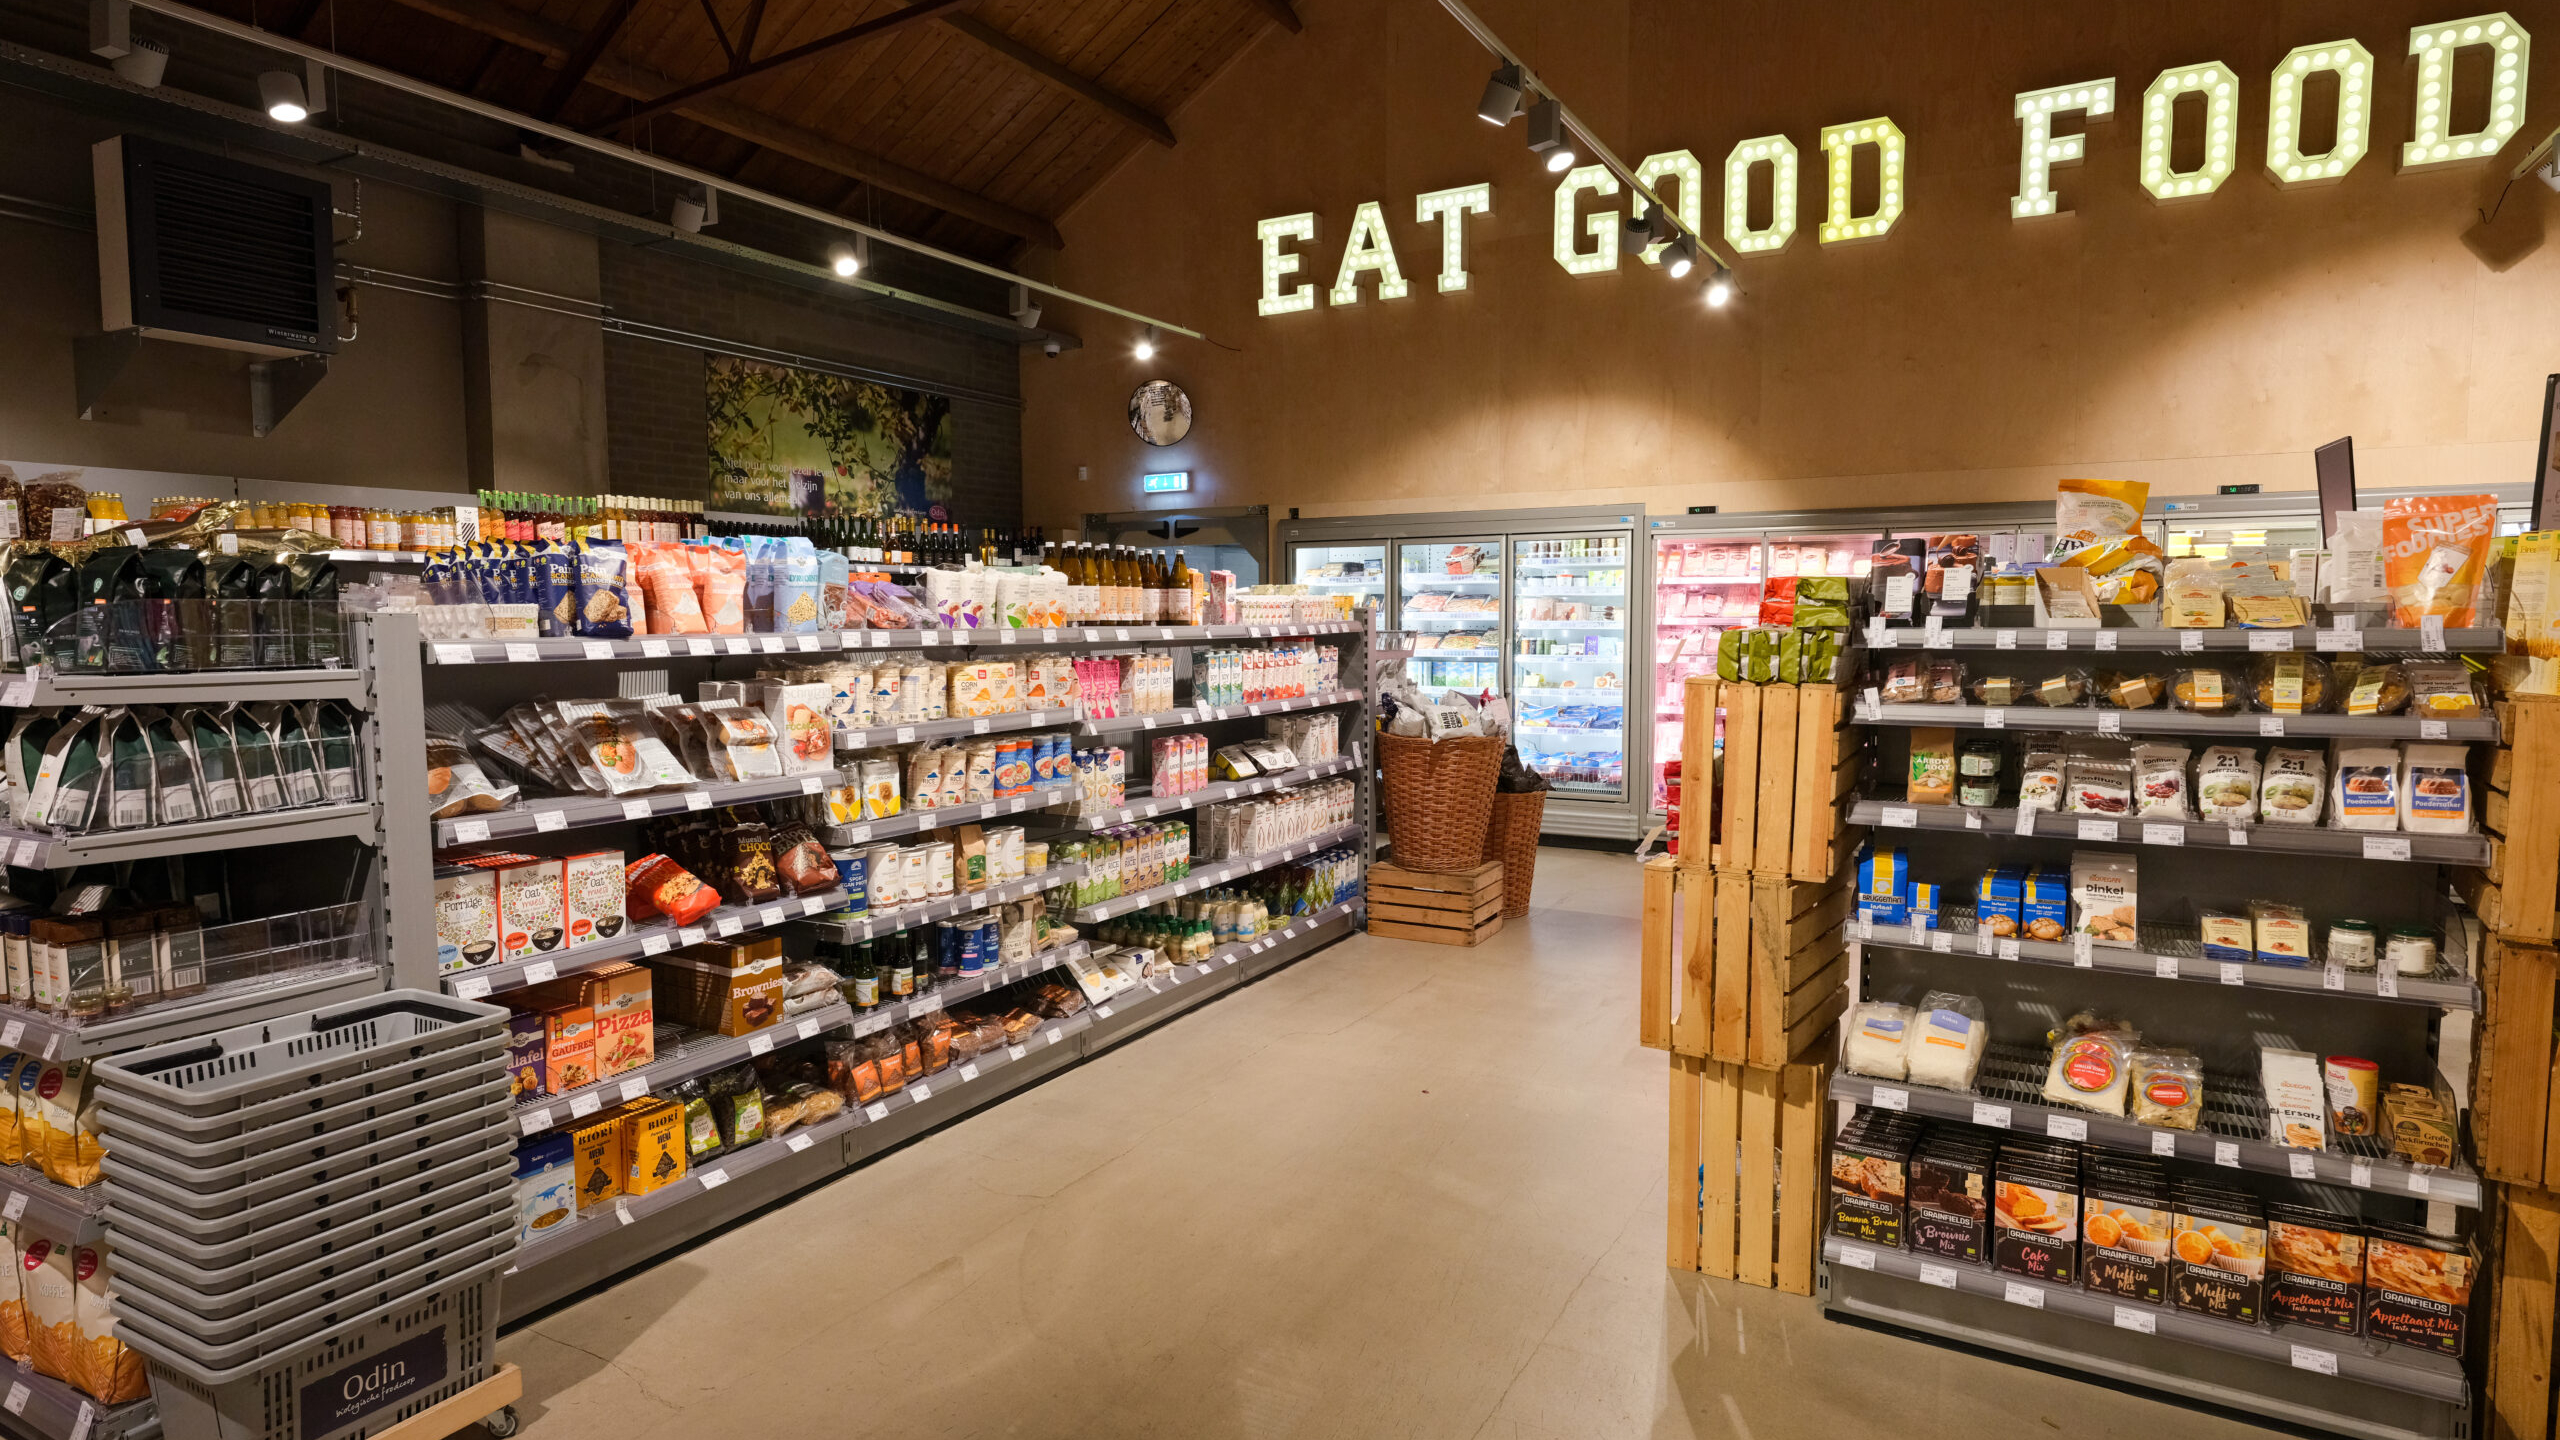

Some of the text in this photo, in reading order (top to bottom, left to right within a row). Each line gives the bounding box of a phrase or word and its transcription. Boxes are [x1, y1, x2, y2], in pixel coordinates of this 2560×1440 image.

[1257, 12, 2531, 316] EAT GOOD FOOD
[268, 329, 308, 340] Winterwarm
[723, 456, 743, 469] Niet
[745, 459, 767, 473] puur
[768, 462, 788, 473] voor
[724, 475, 818, 493] maar voor het welzijn
[724, 489, 801, 504] van ons allemaal
[2407, 503, 2497, 532] SUPER
[2383, 522, 2489, 562] FOODIES
[580, 564, 606, 573] Pain
[1916, 757, 1950, 765] ARROW
[2217, 755, 2240, 767] 2:1
[2280, 759, 2305, 770] 2:1
[738, 835, 762, 844] Muesli
[590, 877, 605, 888] Oat
[2086, 883, 2124, 895] Dinkel
[524, 888, 541, 899] Oat
[444, 897, 483, 913] Porridge
[733, 977, 784, 999] Brownies
[596, 1009, 653, 1039] Pizza
[552, 1039, 594, 1057] GAUFRES
[1844, 1196, 1891, 1213] GRAINFIELDS
[1836, 1211, 1899, 1229] Banana Bread
[1922, 1209, 1971, 1228] GRAINFIELDS
[1860, 1224, 1877, 1237] Mix
[1924, 1225, 1971, 1244] Brownie
[2009, 1229, 2062, 1248] GRAINFIELDS
[1939, 1239, 1956, 1252] Mix
[2021, 1245, 2050, 1263] Cake
[2027, 1259, 2045, 1273] Mix
[2099, 1248, 2154, 1267] GRAINFIELDS
[2104, 1264, 2149, 1288] Muffin
[2189, 1264, 2247, 1285] GRAINFIELDS
[2284, 1273, 2344, 1292] GRAINFIELDS
[2117, 1277, 2137, 1293] Mix
[2194, 1281, 2243, 1305] Muffin
[2209, 1294, 2229, 1311] Mix
[2271, 1290, 2355, 1310] Appeltaart Mix
[2384, 1291, 2448, 1313] GRAINFIELDS
[2370, 1307, 2460, 1332] Appeltaart Mix
[343, 1360, 405, 1400] Odin
[336, 1377, 416, 1418] biologische foodcoop
